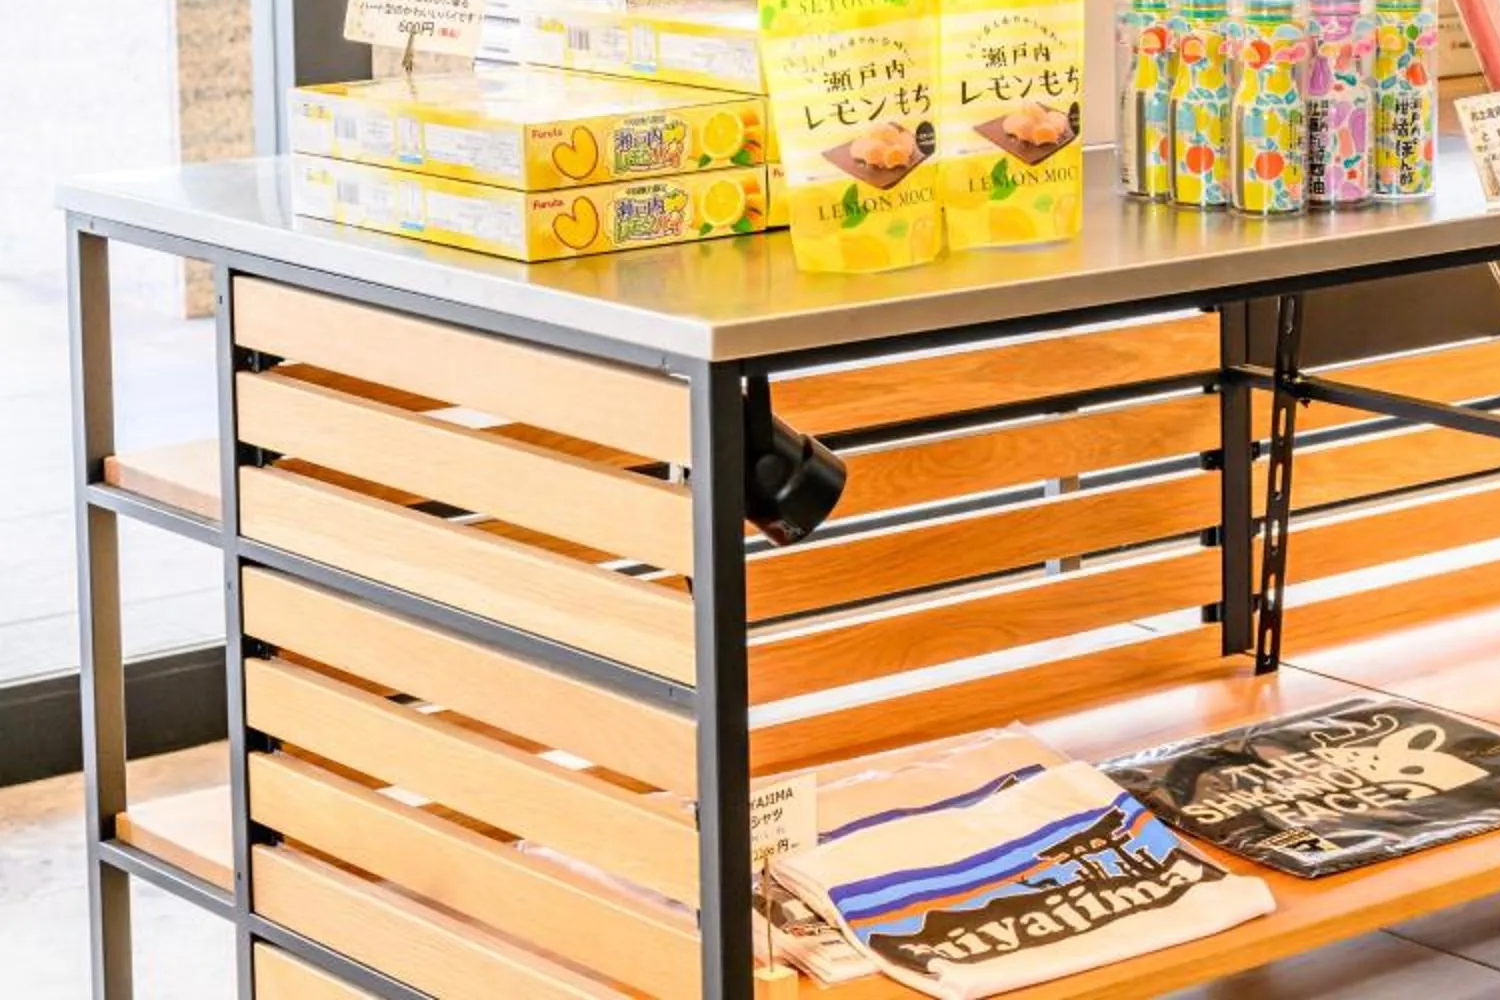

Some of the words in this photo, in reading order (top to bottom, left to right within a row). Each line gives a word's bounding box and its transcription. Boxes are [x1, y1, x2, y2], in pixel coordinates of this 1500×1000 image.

[980, 41, 1052, 69] 瀬戸内
[823, 58, 906, 93] 瀬戸内
[960, 64, 1080, 105] レモンもち
[803, 83, 932, 130] レモンもち
[968, 168, 1040, 194] LEMON
[818, 194, 893, 223] LEMON
[1221, 746, 1332, 791] THE
[1272, 785, 1410, 828] FACE
